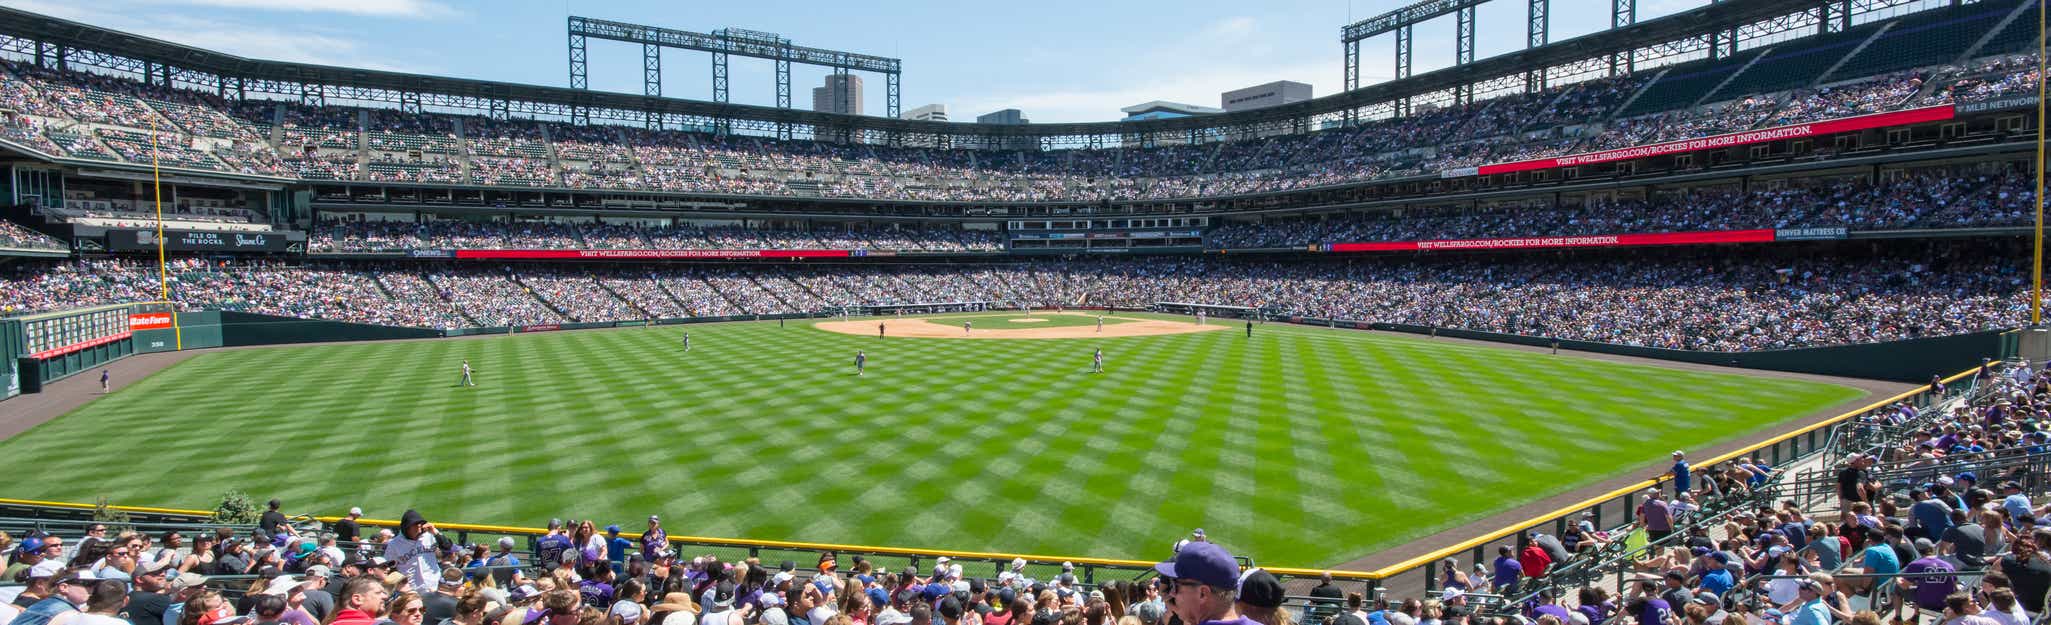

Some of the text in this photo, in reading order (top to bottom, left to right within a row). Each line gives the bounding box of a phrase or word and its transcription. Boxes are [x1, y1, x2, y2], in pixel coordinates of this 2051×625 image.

[1966, 103, 1987, 112] MLB
[1555, 126, 1813, 166] VISIT WELLSFARGO.COM/ROCKIES FOR MORE INFORMATION.
[1803, 228, 1835, 236] MATTRESS
[1541, 238, 1564, 246] MORE
[1565, 236, 1619, 245] INFORMATION.
